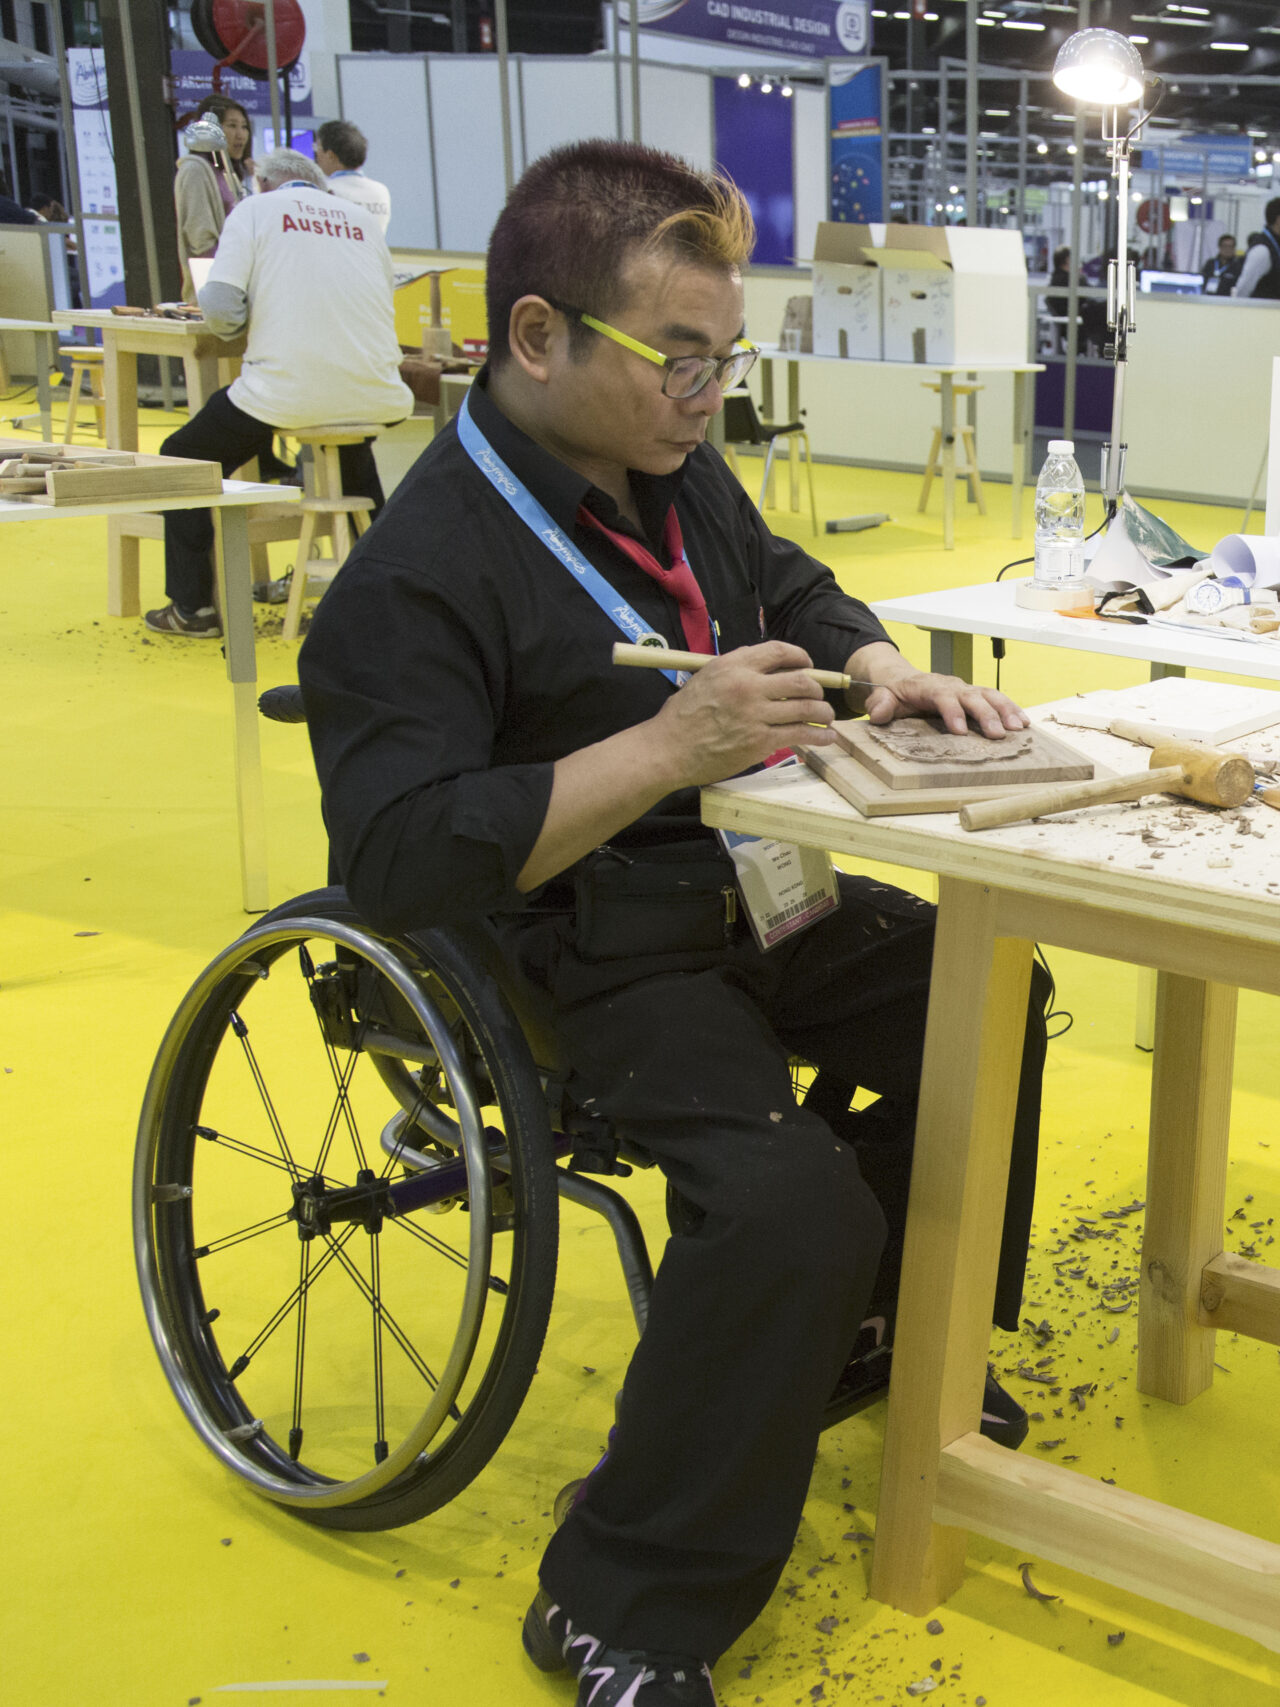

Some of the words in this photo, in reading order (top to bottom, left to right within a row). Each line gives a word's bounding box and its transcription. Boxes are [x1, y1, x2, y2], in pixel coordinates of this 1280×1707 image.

[731, 6, 792, 31] INDUSTRIAL
[794, 16, 830, 36] DESIGN
[295, 199, 347, 220] Team
[282, 213, 365, 242] Austria
